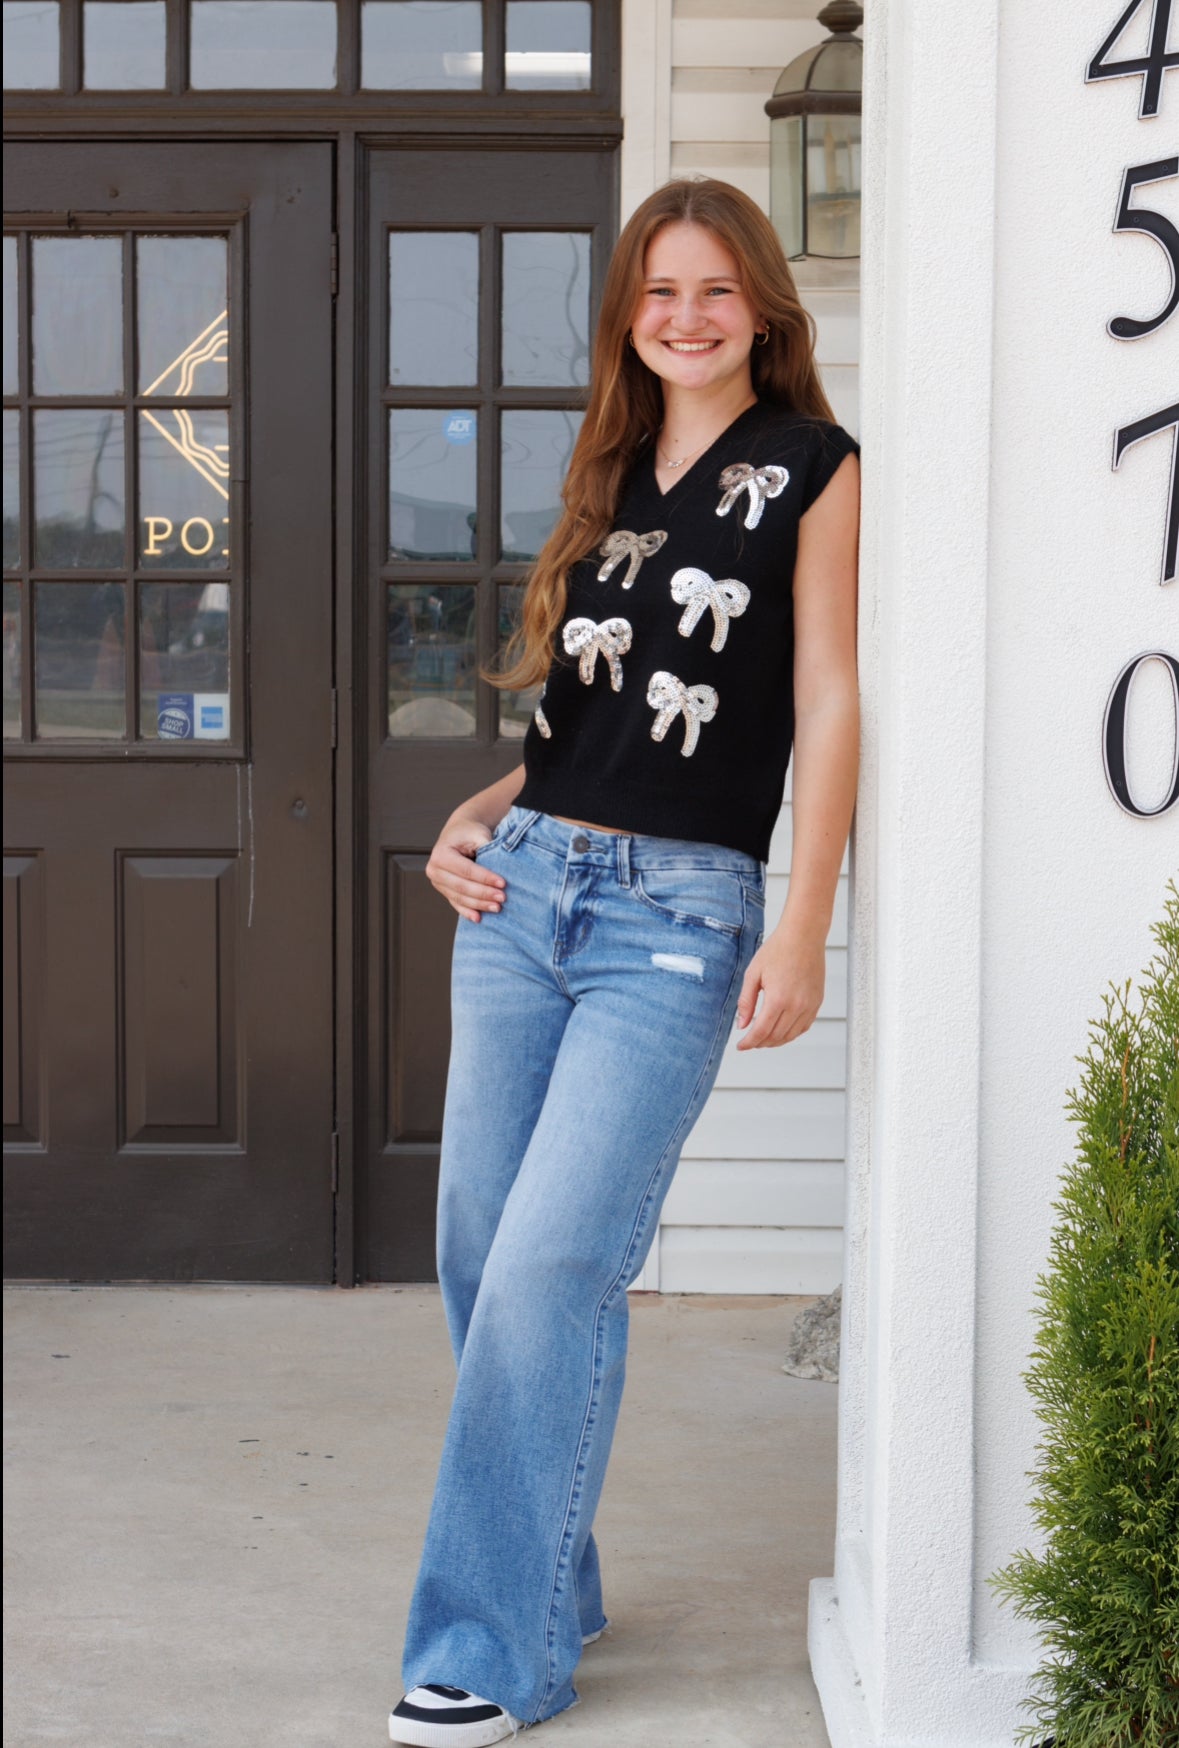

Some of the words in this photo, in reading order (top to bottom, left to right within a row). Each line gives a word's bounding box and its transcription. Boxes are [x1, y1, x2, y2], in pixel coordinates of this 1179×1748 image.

[447, 419, 472, 433] ADT
[161, 722, 183, 734] SMALL
[164, 717, 184, 727] SHOP
